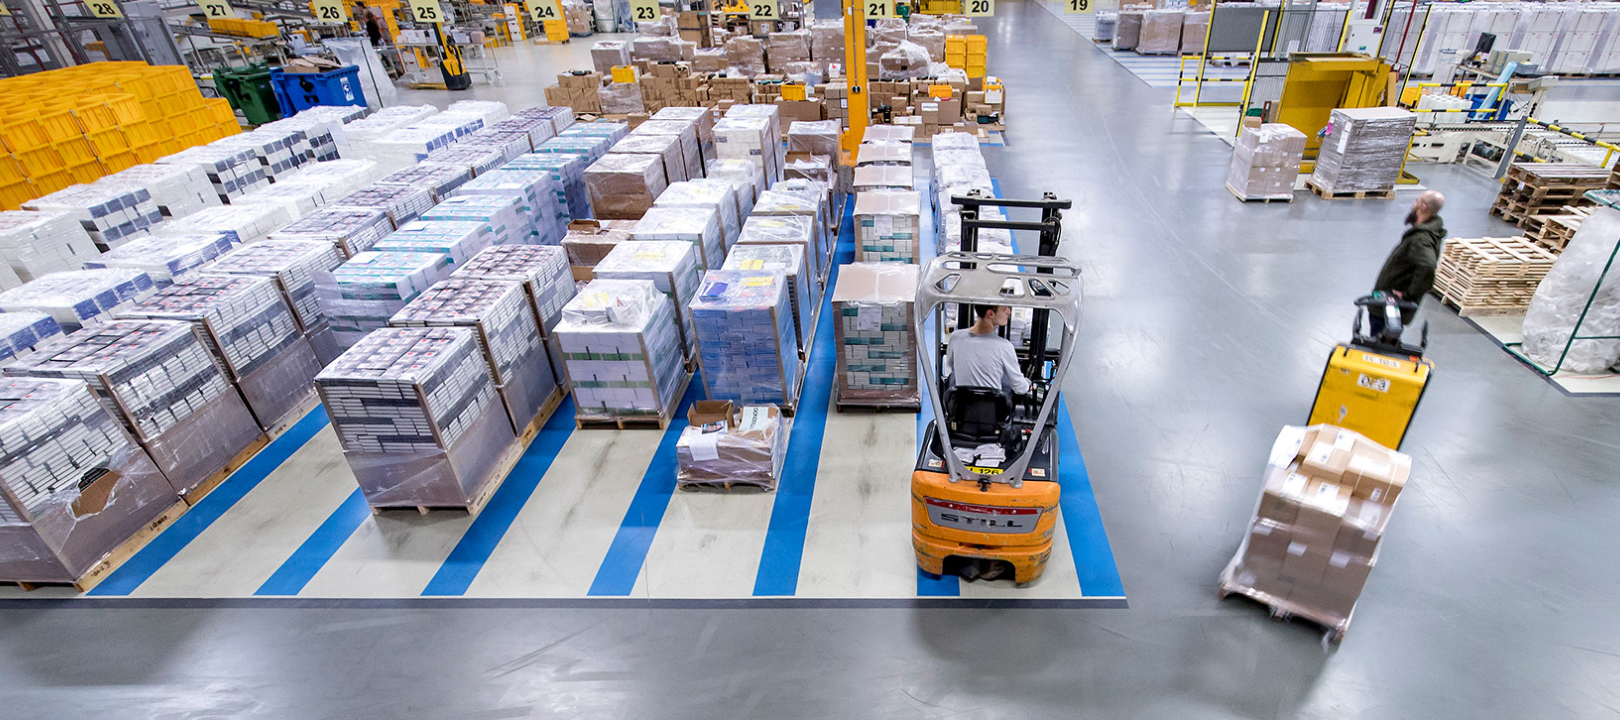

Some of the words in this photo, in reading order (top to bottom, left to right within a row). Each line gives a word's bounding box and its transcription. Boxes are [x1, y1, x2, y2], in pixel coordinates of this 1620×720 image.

[93, 2, 115, 15] 28
[207, 4, 227, 16] 27
[534, 5, 555, 18] 24
[753, 4, 773, 17] 22
[868, 2, 886, 16] 21
[971, 0, 990, 13] 20
[1070, 0, 1088, 11] 19
[319, 6, 339, 19] 26
[416, 6, 437, 20] 25
[636, 6, 655, 20] 23
[940, 512, 1023, 527] STILL
